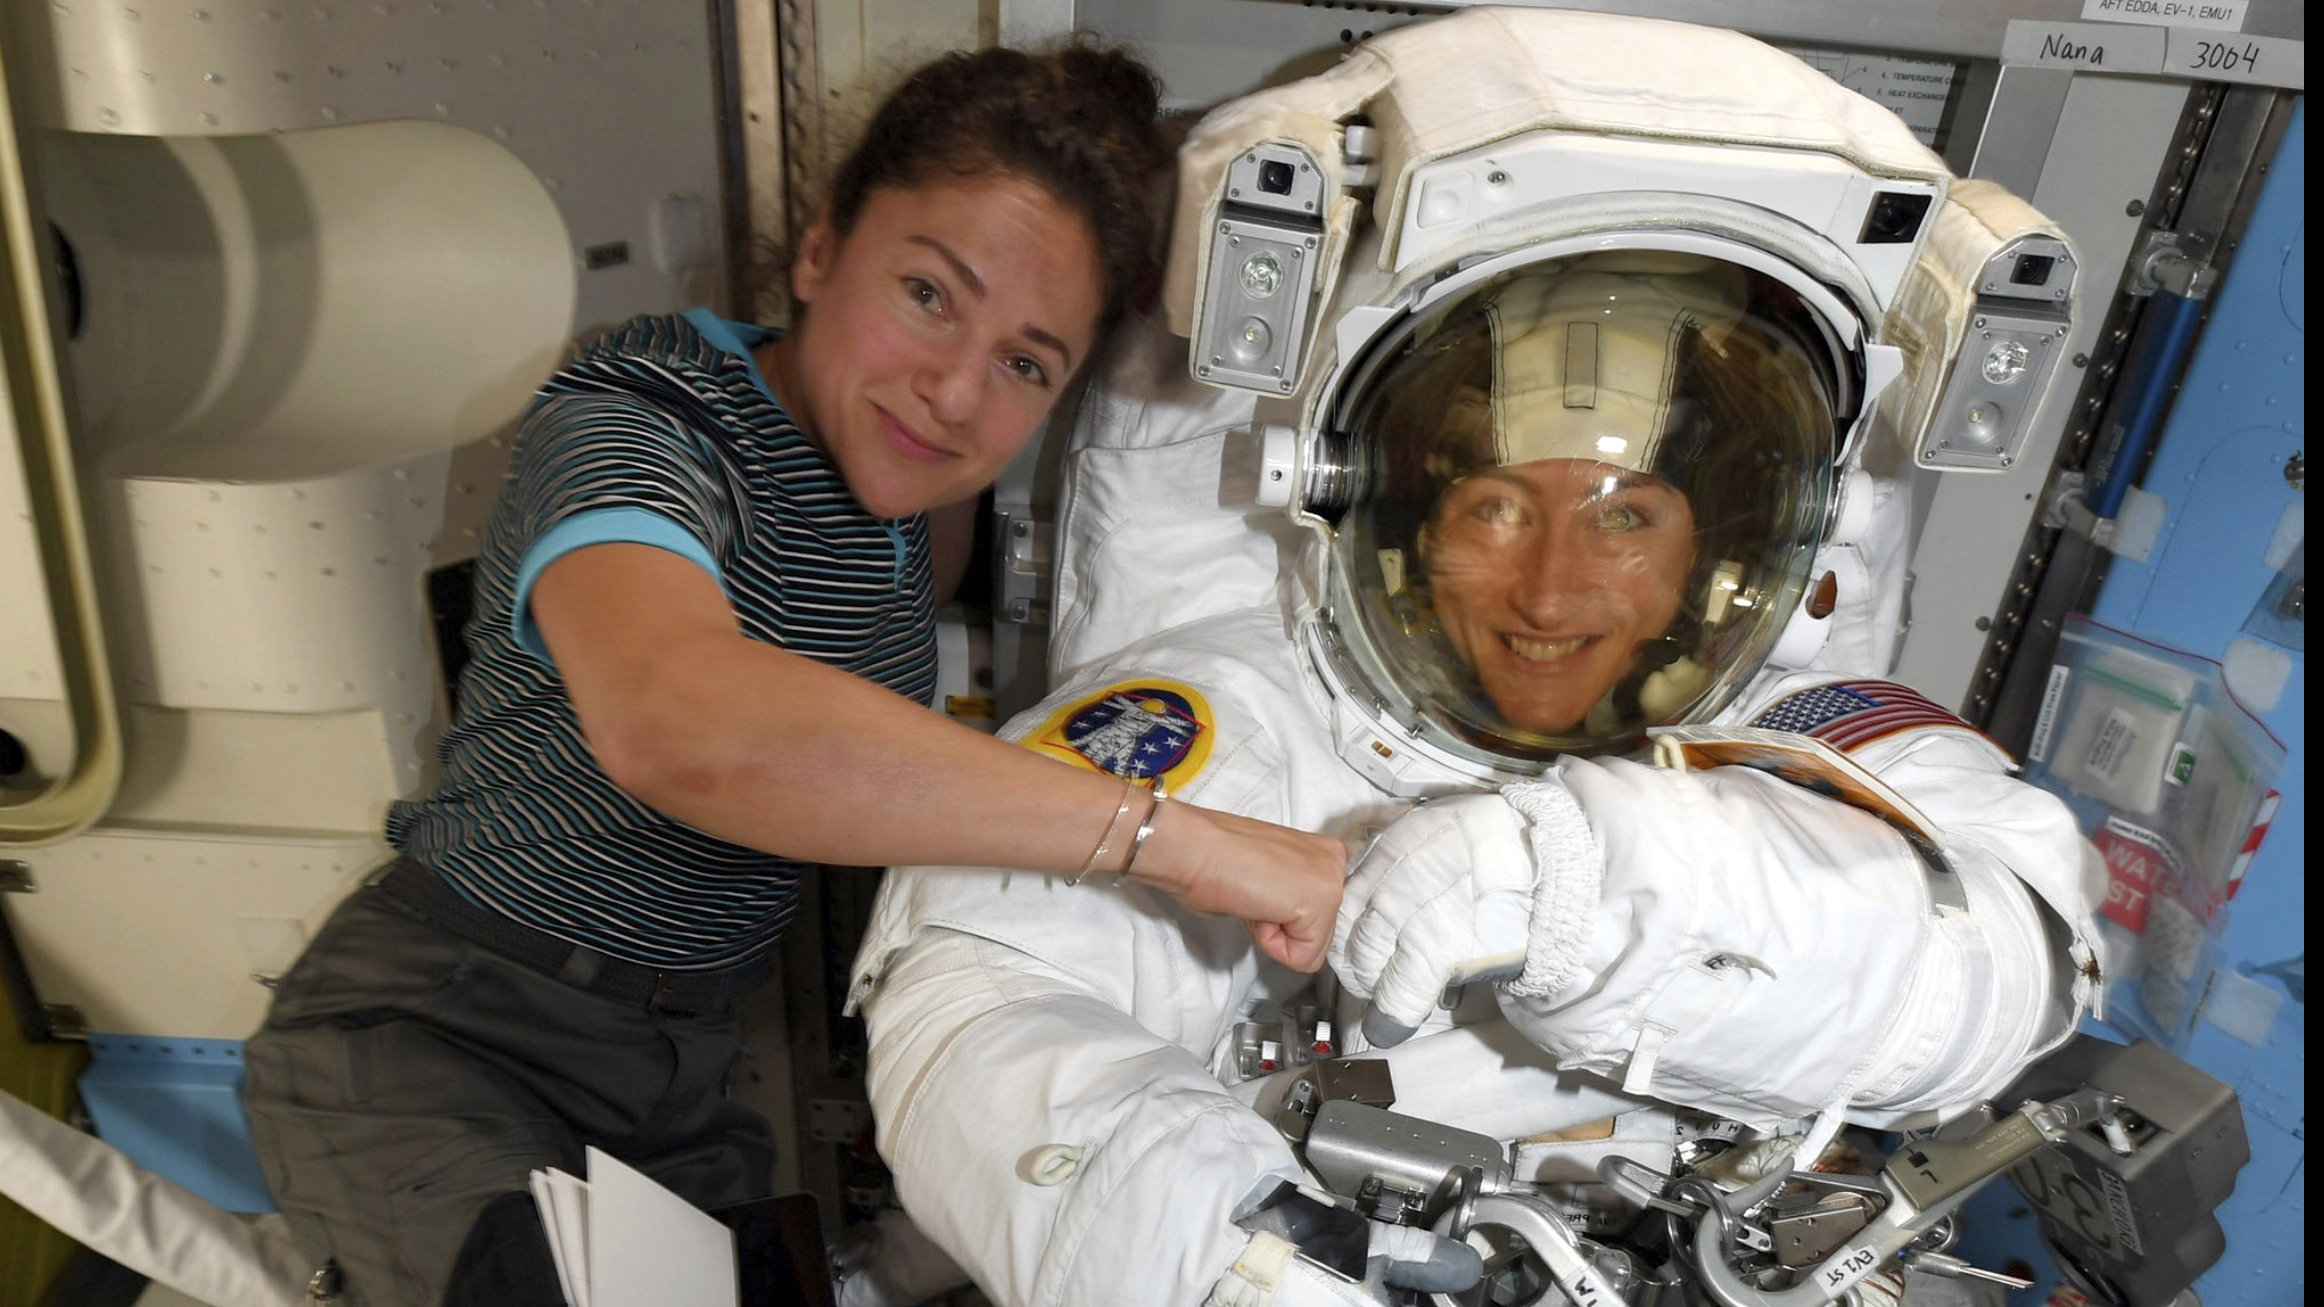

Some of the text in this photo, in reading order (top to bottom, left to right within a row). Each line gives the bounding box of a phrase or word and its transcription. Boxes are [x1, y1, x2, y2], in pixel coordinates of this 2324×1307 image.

[2099, 0, 2232, 20] AFT EDDA, EV-1, EMU1
[2040, 34, 2104, 65] Nana
[1893, 72, 1944, 83] TEMPERATURE
[1826, 1249, 1875, 1287] EV1 ST
